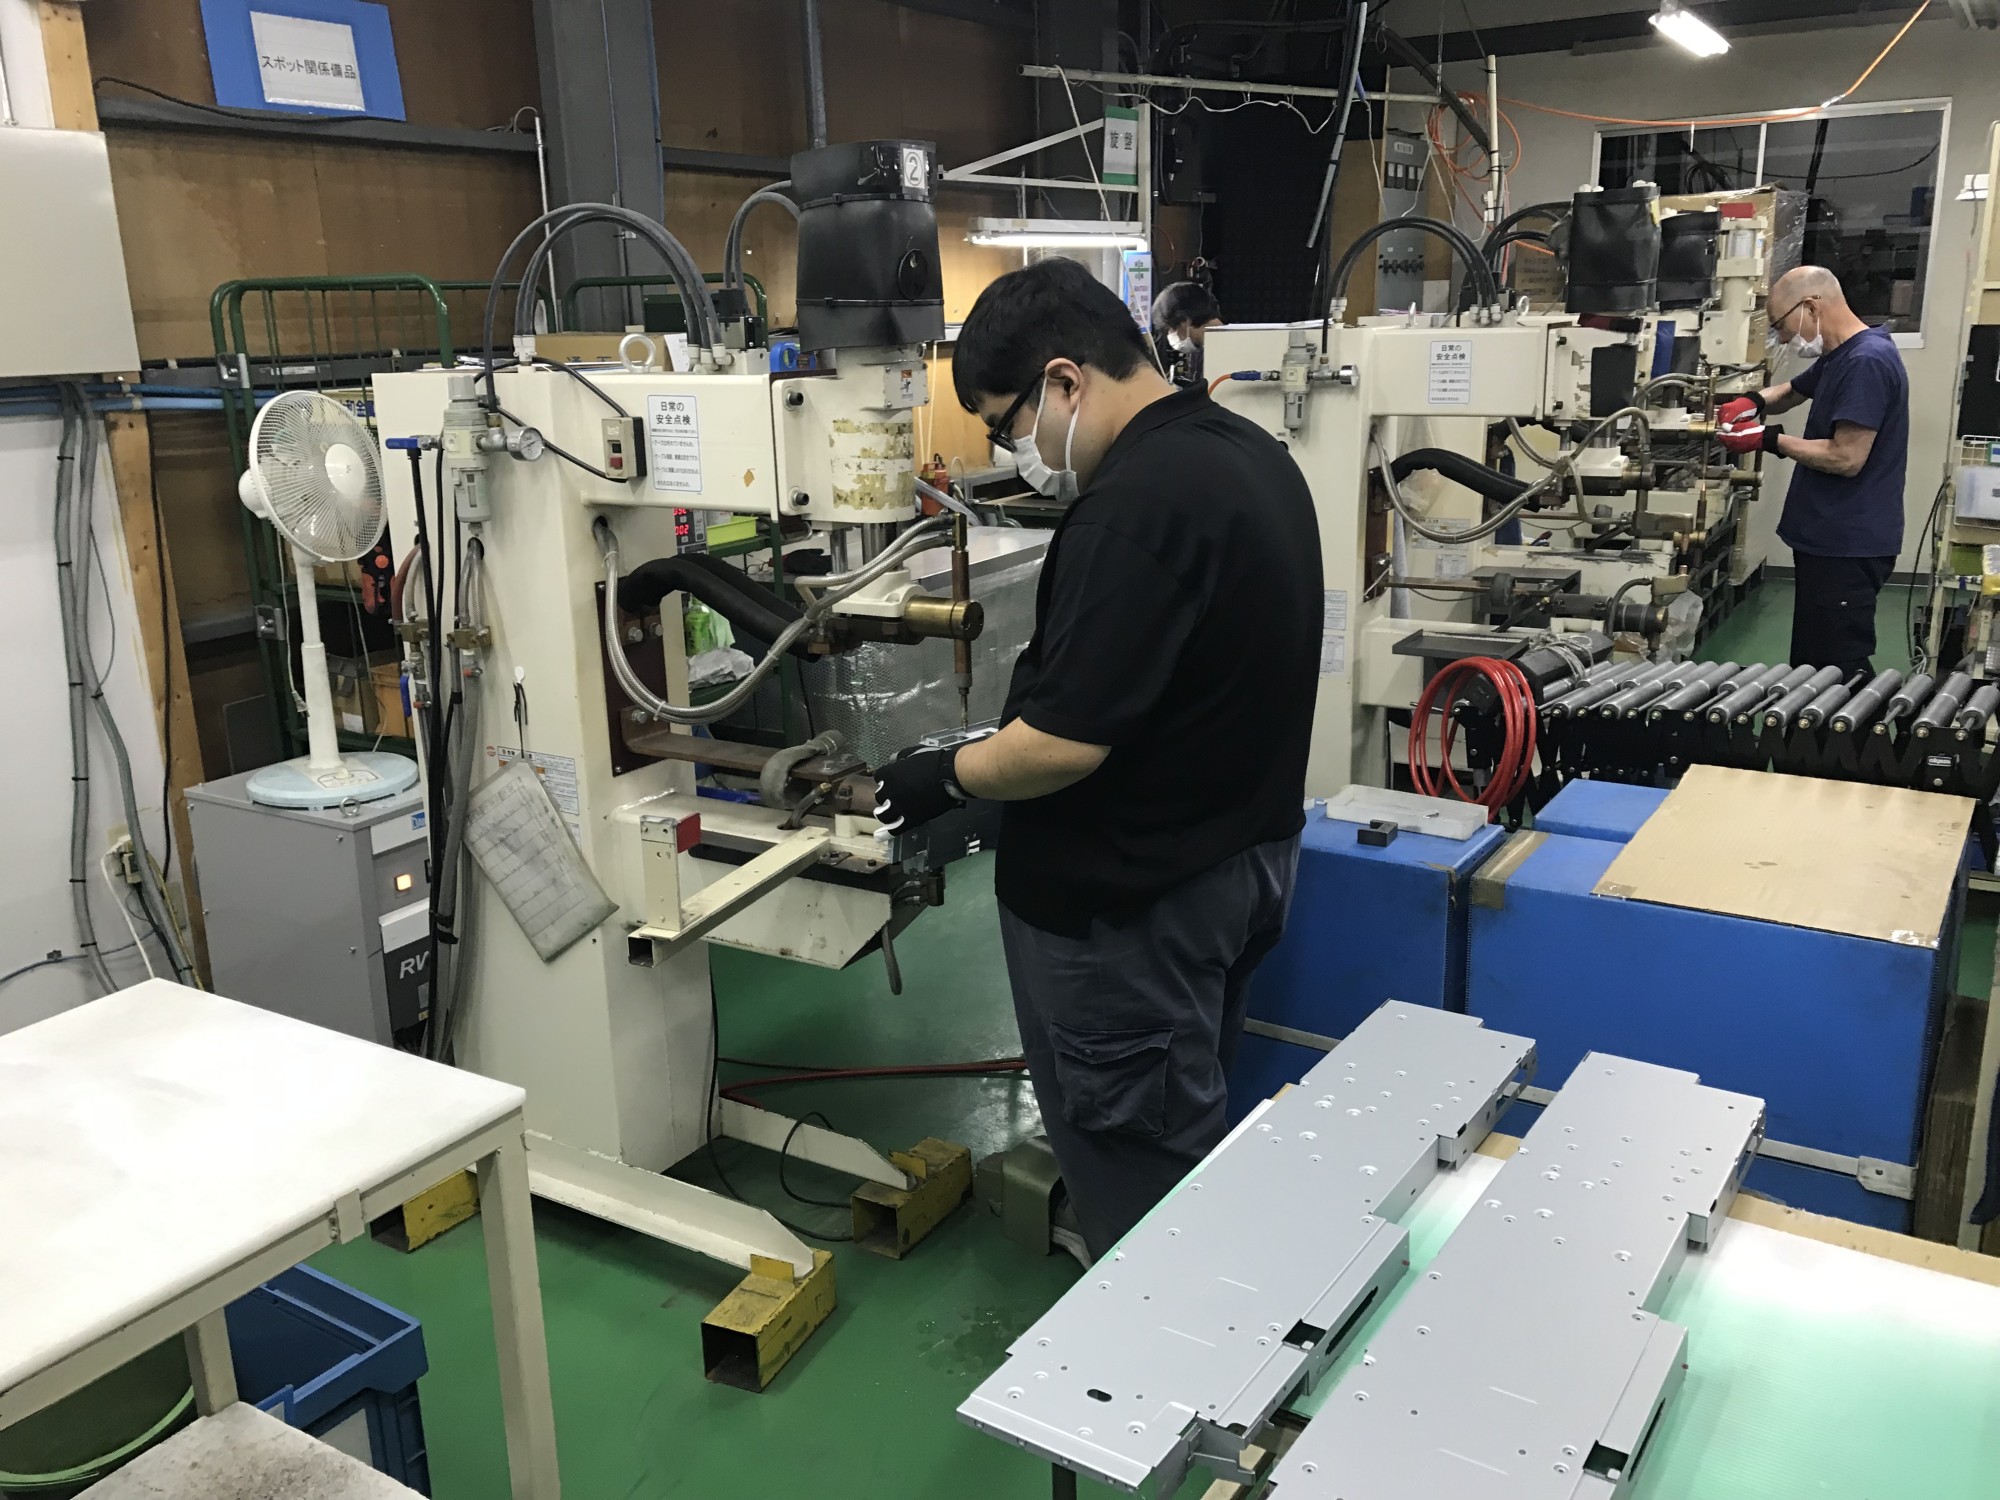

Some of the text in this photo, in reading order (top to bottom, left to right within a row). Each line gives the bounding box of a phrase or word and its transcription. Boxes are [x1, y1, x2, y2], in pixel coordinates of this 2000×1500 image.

[262, 55, 357, 79] スポット関係備品
[660, 401, 685, 412] 日常の
[656, 413, 692, 426] 安全点検
